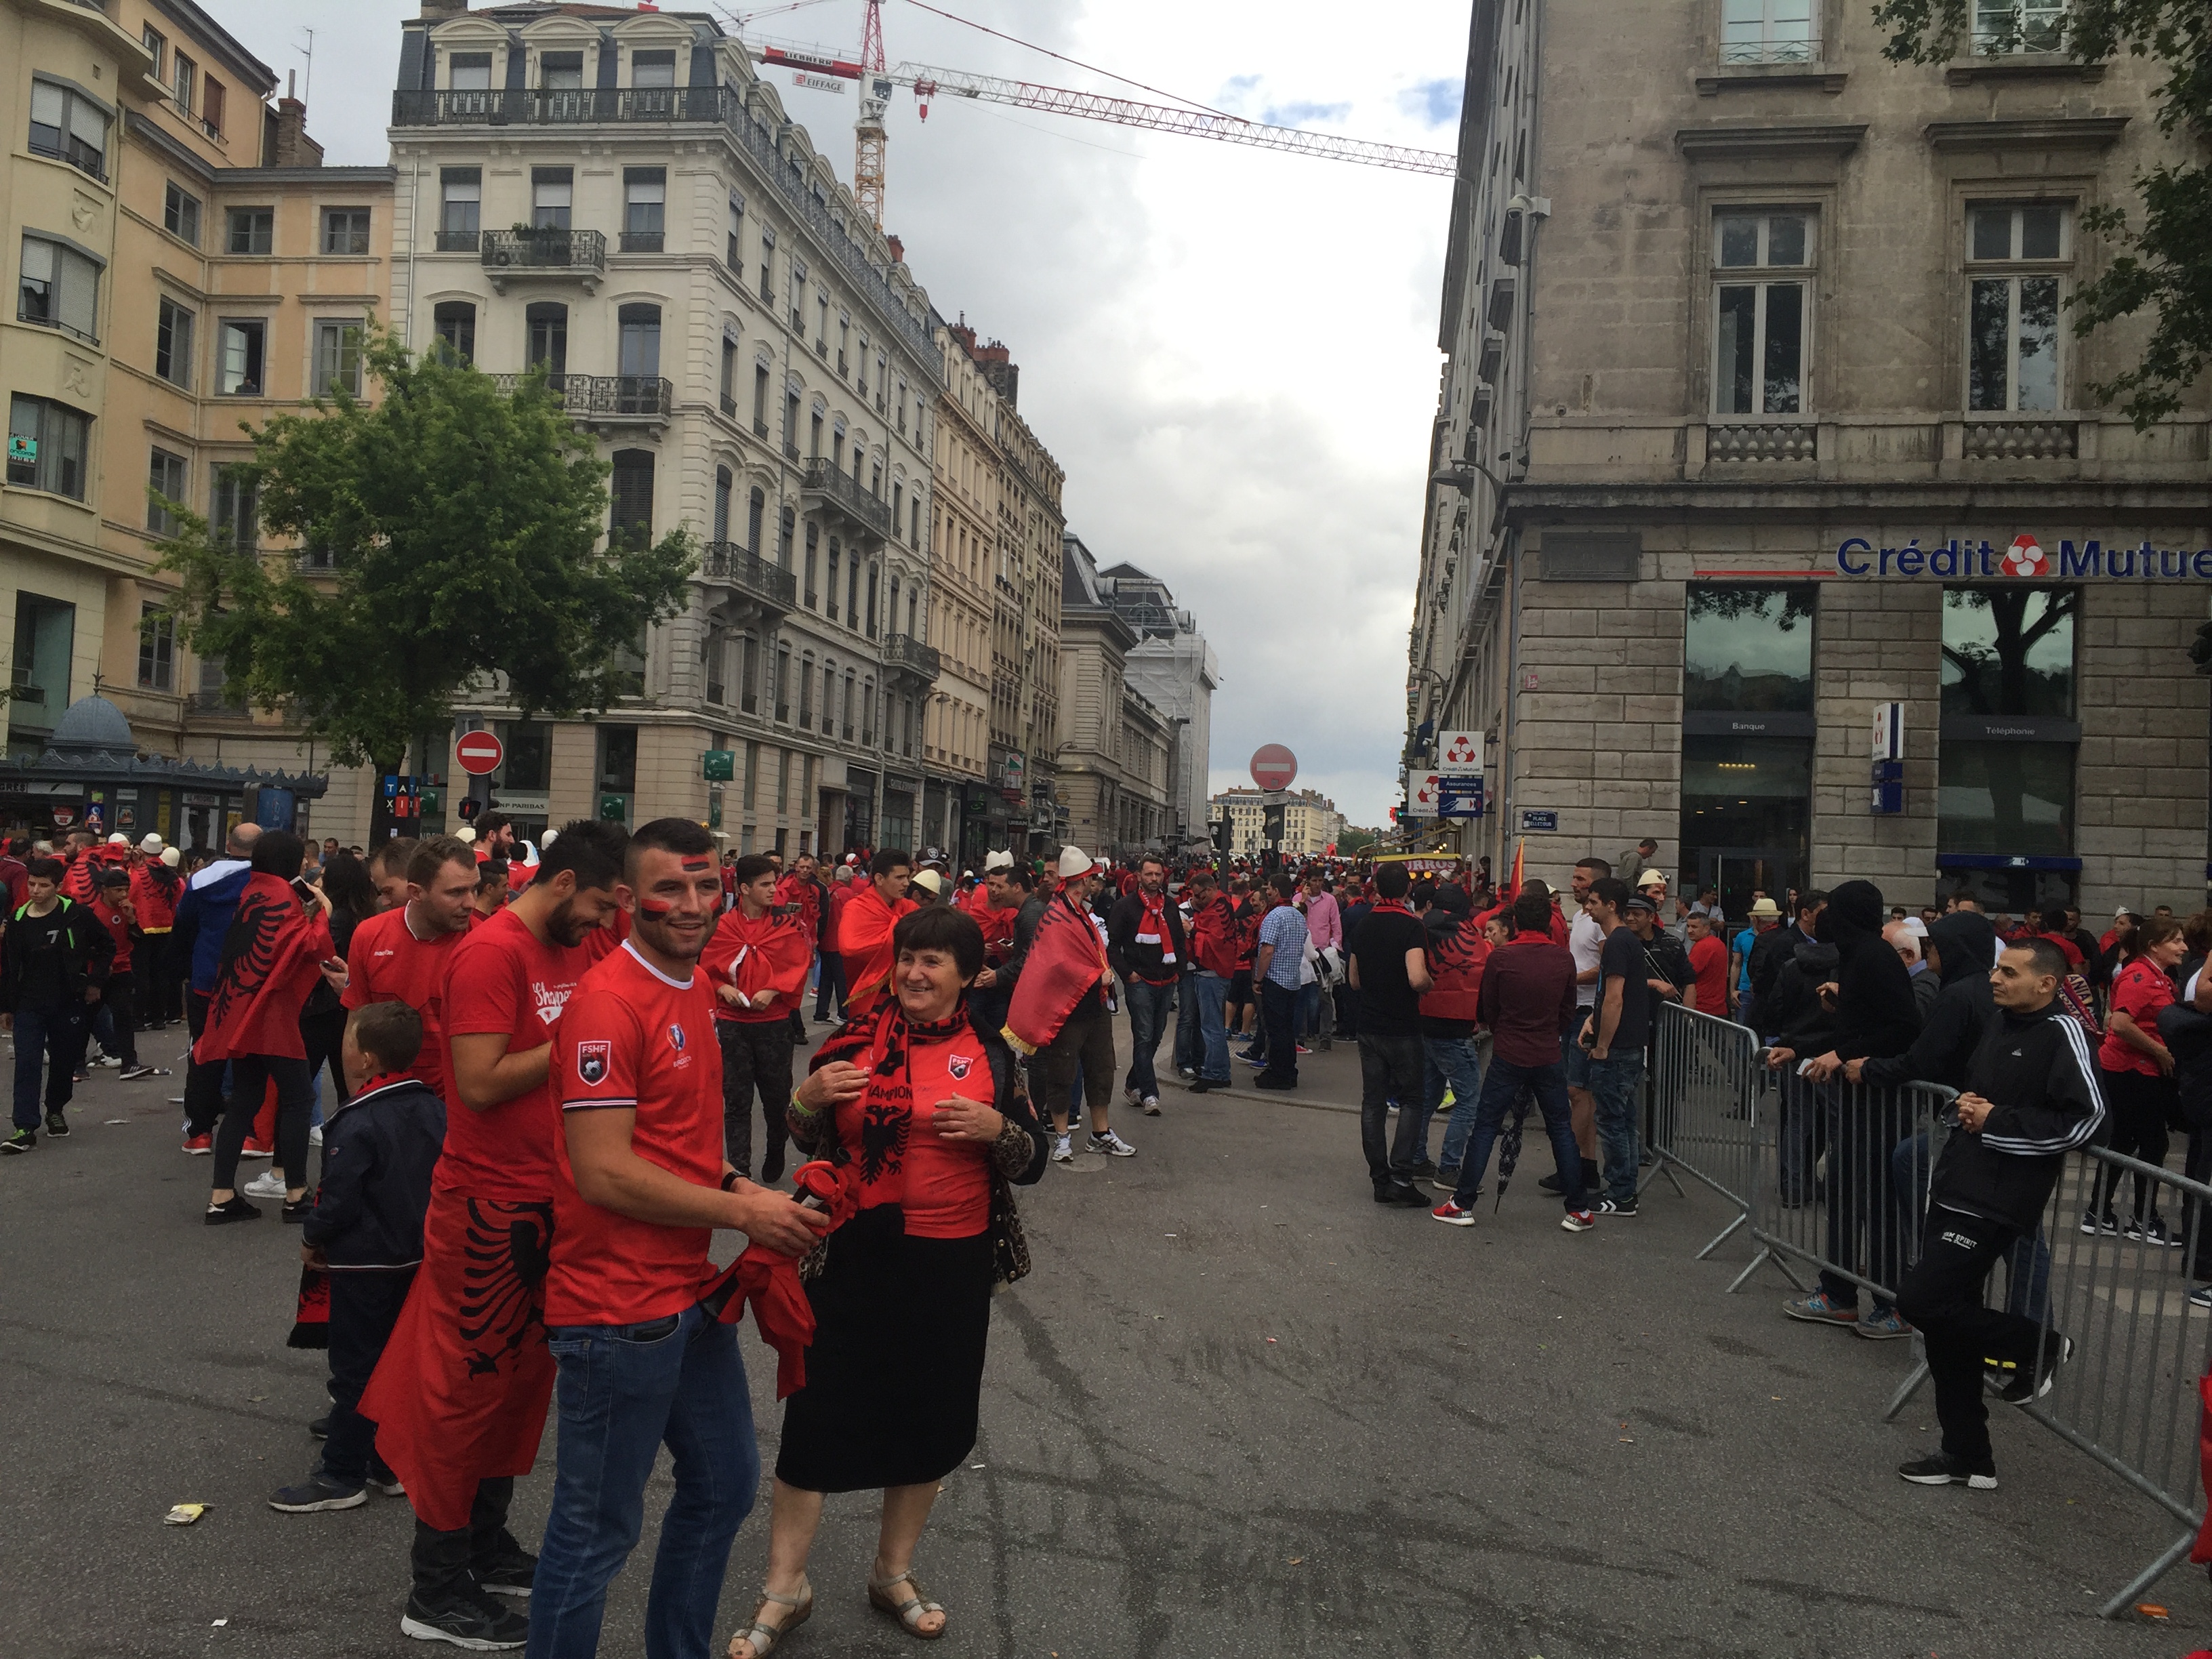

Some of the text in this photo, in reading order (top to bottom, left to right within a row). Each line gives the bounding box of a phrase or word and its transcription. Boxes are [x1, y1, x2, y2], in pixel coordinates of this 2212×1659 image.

[785, 52, 832, 66] LIEBHERR
[807, 78, 842, 91] EIFFAGE
[1837, 537, 1994, 576] Crédit
[1732, 722, 1765, 731] Banque
[1986, 726, 2036, 735] Téléphonie
[46, 930, 60, 944] 7
[581, 1045, 607, 1054] FSHF
[1955, 1234, 1978, 1248] SPIRIT
